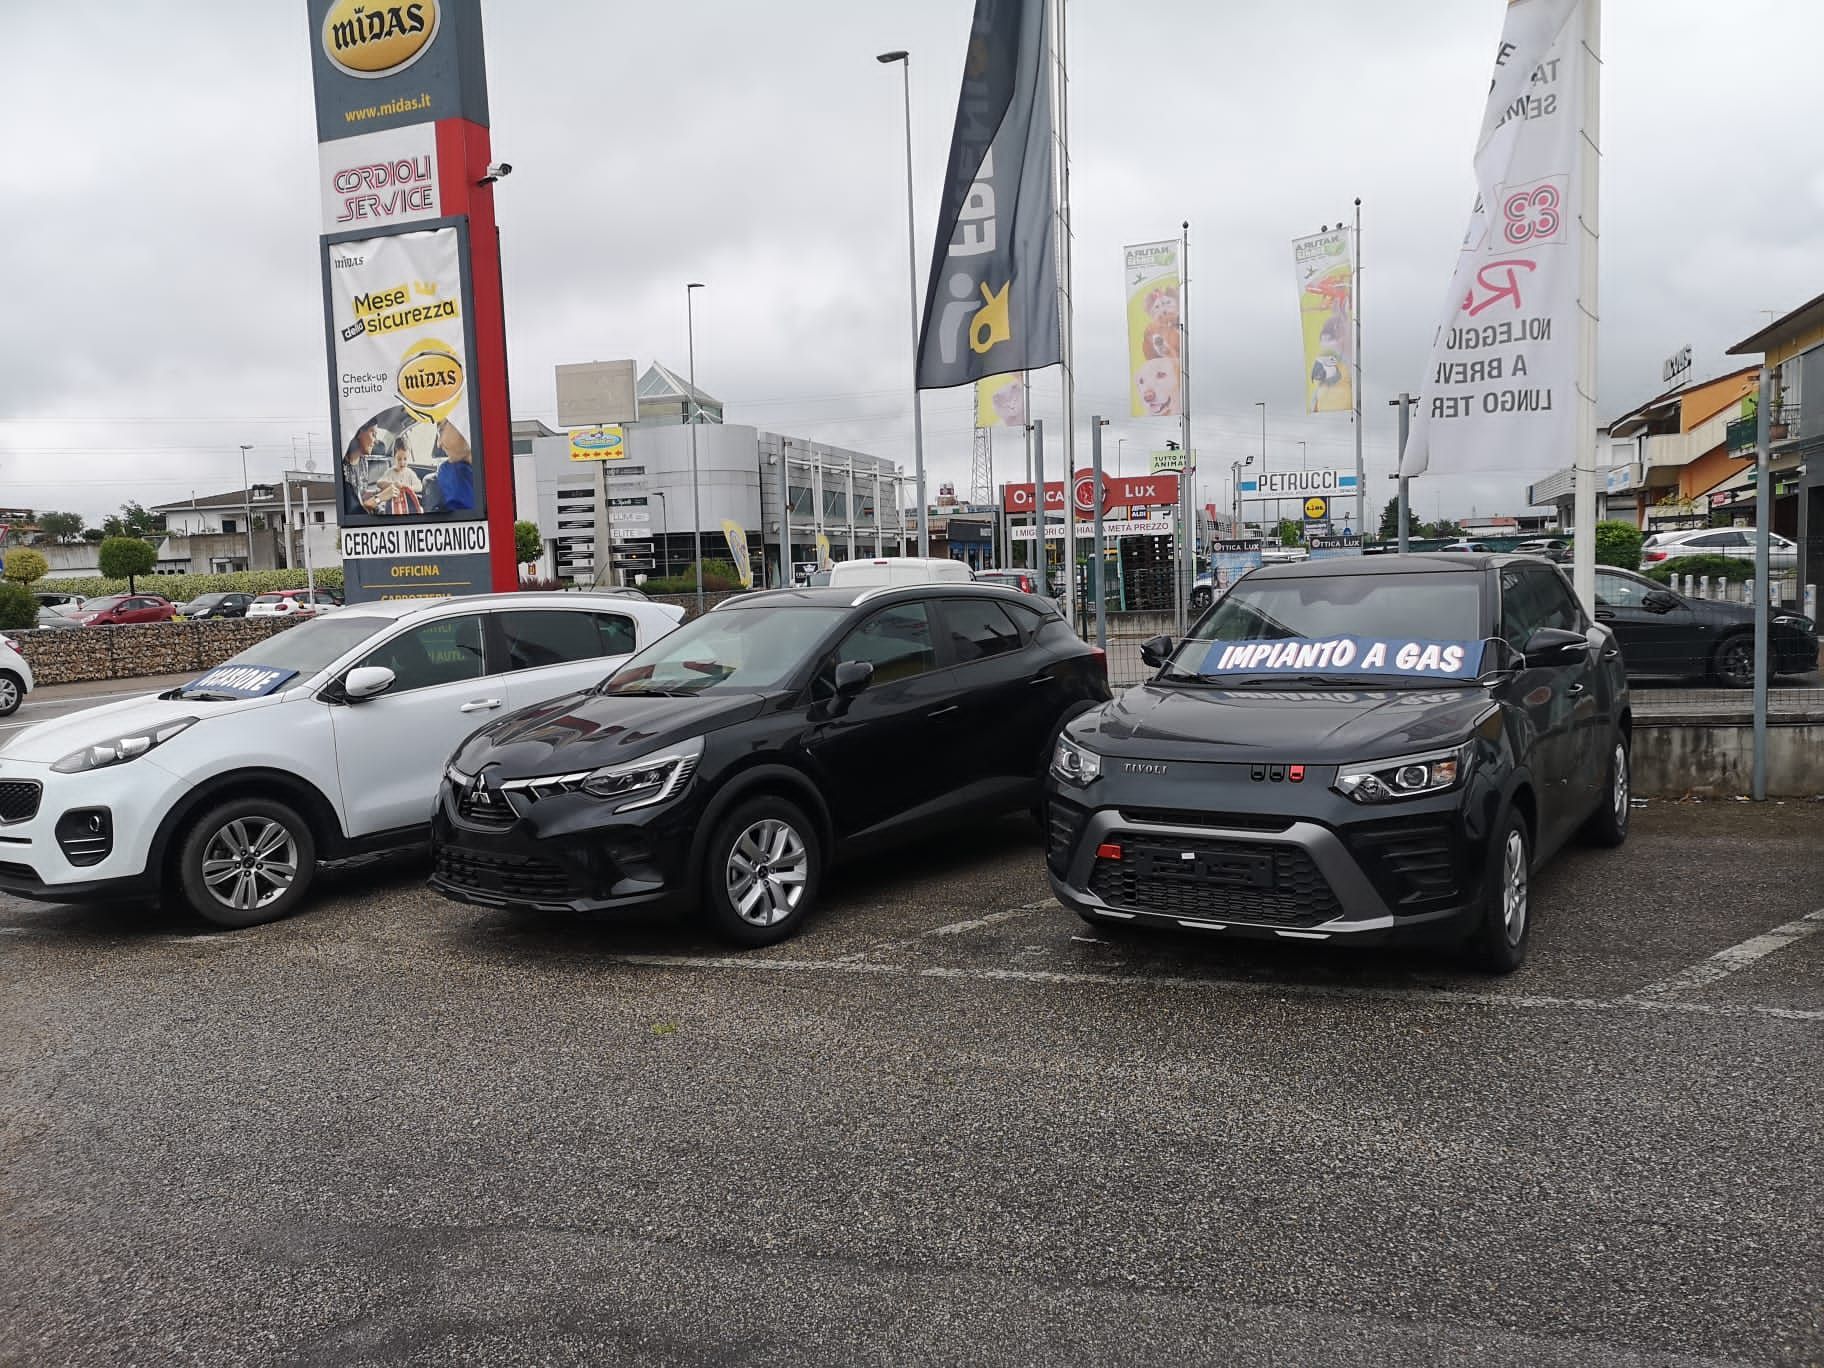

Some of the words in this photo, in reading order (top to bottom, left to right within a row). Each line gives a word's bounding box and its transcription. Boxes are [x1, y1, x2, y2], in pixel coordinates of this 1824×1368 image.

[345, 93, 431, 122] www.midas.it
[334, 155, 432, 194] CORDIOLI
[336, 185, 433, 222] SERVICE
[354, 290, 405, 314] Mese
[368, 300, 455, 332] sicurezza
[342, 372, 388, 385] Check-up
[342, 384, 383, 398] gratuito
[1258, 471, 1337, 492] PETRUCCI
[1134, 522, 1169, 531] PREZZO
[344, 530, 400, 556] CERCASI
[404, 526, 486, 553] MECCANICO
[391, 565, 440, 577] OFFICINA
[1217, 639, 1357, 670] IMPIANTO
[1361, 643, 1387, 669] A
[1395, 642, 1464, 672] GAS
[1124, 763, 1168, 775] TIVOLI
